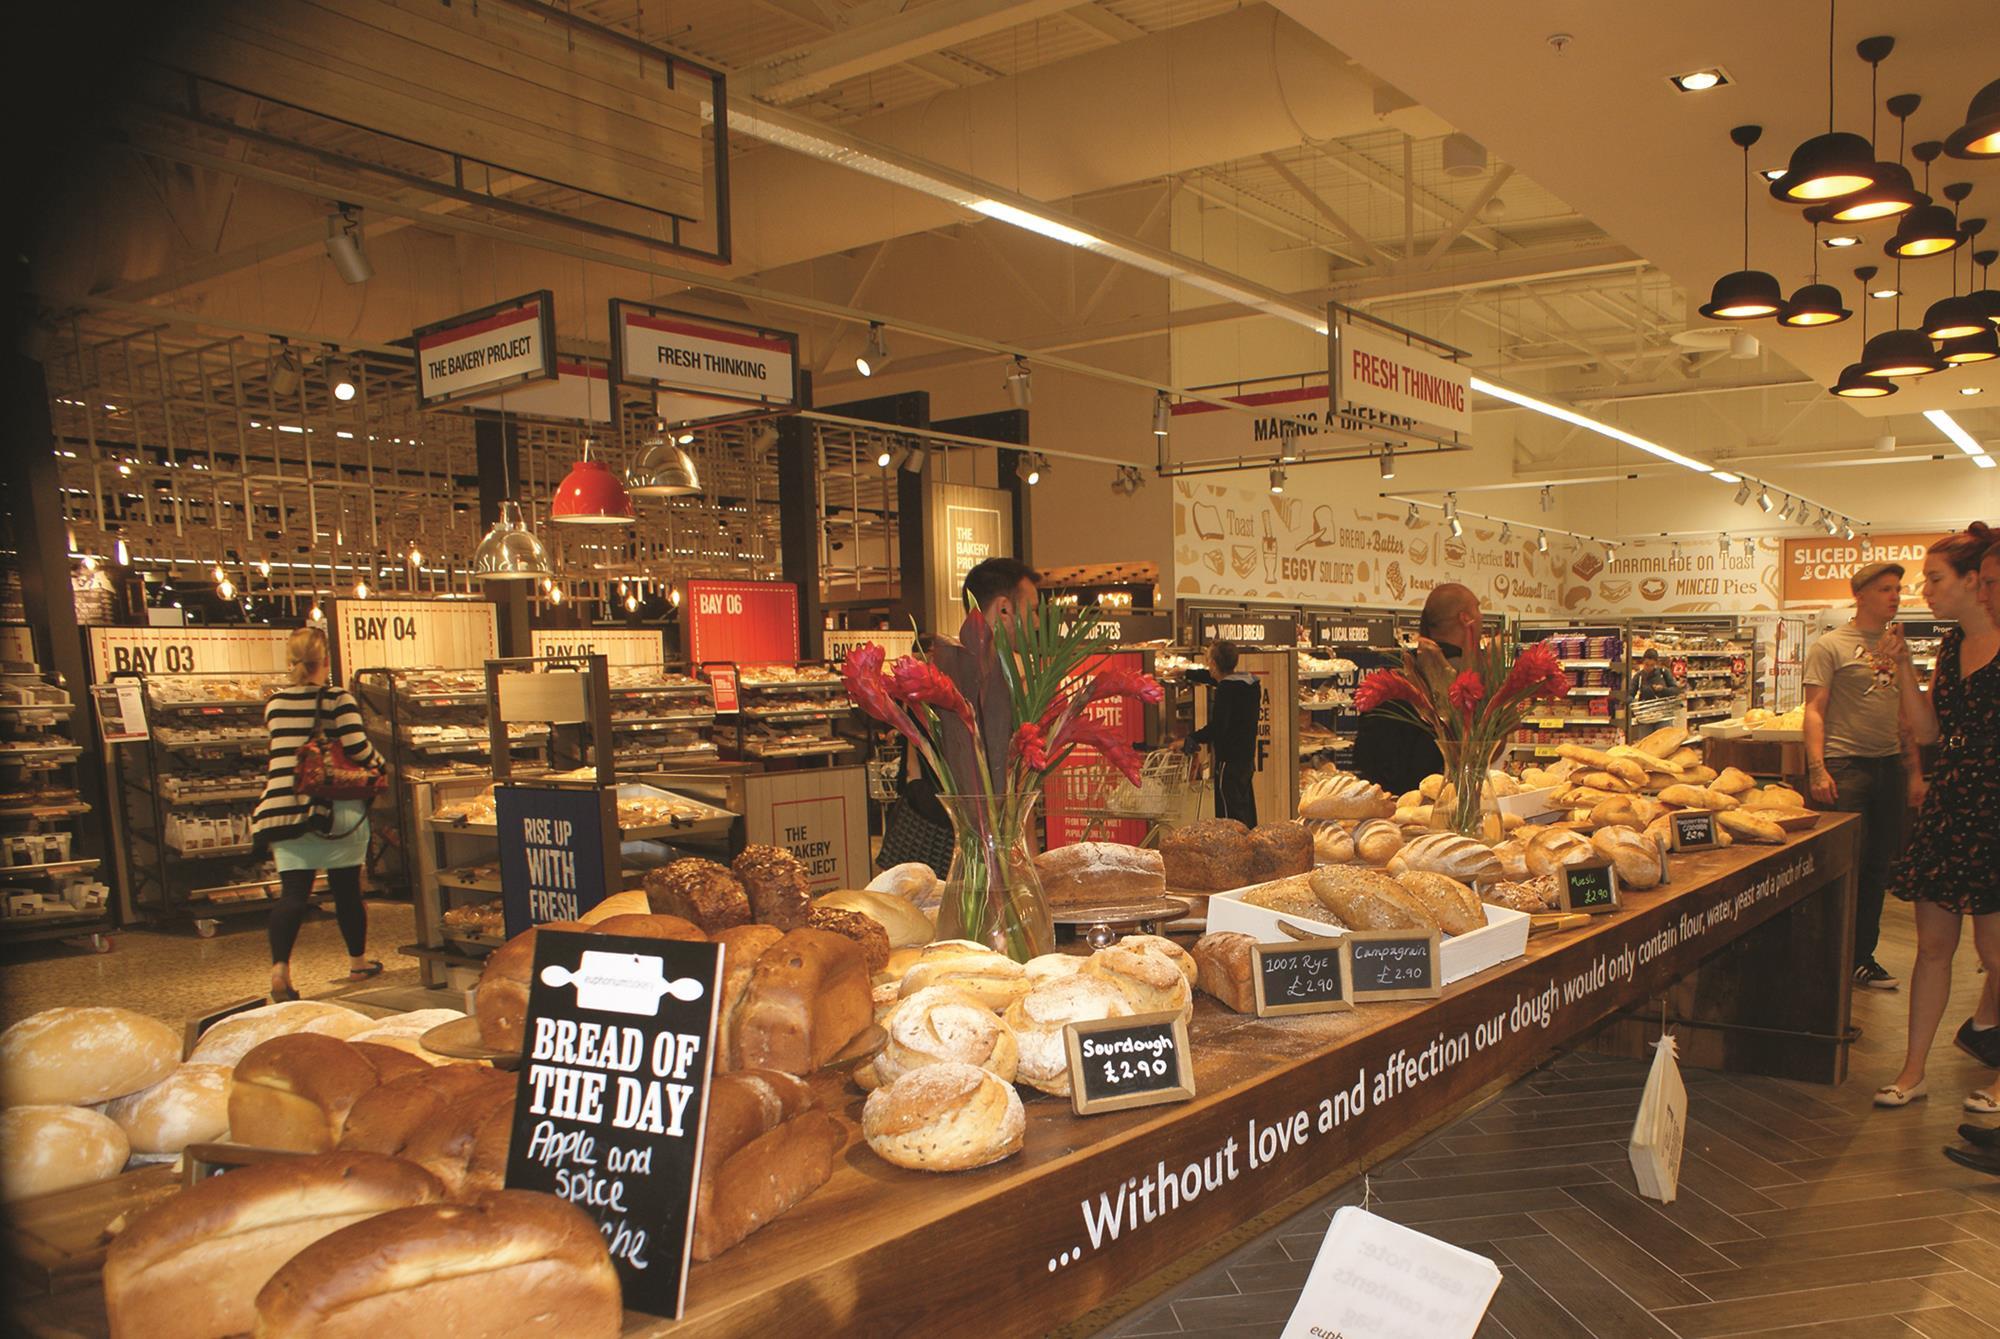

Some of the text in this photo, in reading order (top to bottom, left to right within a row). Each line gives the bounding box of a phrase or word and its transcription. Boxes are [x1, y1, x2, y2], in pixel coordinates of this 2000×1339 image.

[428, 335, 532, 380] THE BAKERY PROJECT
[657, 345, 767, 381] FRESH THINKING
[1352, 349, 1464, 413] FRESH THINKING
[956, 527, 973, 541] THE
[1226, 508, 1255, 538] Toast
[956, 541, 990, 556] BAKERY
[1339, 527, 1366, 550] BREAD
[1469, 547, 1476, 564] A
[1504, 549, 1520, 569] BLT
[1609, 552, 1755, 574] MARMALADE ON Toast
[1794, 545, 1926, 565] SLICED BREAD
[1281, 556, 1354, 585] EGGY SOLDIERS
[1813, 562, 1873, 580] CAKE
[1676, 577, 1758, 596] MINCED Pies
[699, 593, 743, 615] BAY 06
[354, 616, 417, 641] BAY 04
[1071, 620, 1121, 640] UETTES
[1217, 623, 1265, 641] WORLD BREAD
[1331, 626, 1369, 642] LOCAL HEROES
[114, 644, 195, 673] BAY 03
[545, 644, 573, 666] BAY
[523, 817, 573, 847] RISE UP
[784, 826, 808, 843] THE
[525, 847, 577, 890] WITH
[807, 857, 837, 876] JECT
[528, 888, 579, 922] FRESH
[1265, 957, 1298, 973] 100%
[1248, 1109, 1309, 1170] love
[1317, 1069, 1365, 1133] and
[1372, 1031, 1469, 1108] affection
[1474, 1011, 1506, 1052] our
[1509, 978, 1560, 1029] dough
[1563, 954, 1605, 1006] would
[1608, 944, 1636, 984] only
[1638, 917, 1678, 965] contain
[1679, 910, 1706, 942] flour,
[1706, 897, 1734, 929] water,
[1734, 884, 1755, 921] yeast
[1755, 872, 1770, 901] and
[1770, 877, 1775, 895] a
[1775, 863, 1794, 899] pinch
[1794, 856, 1802, 880] of
[531, 1016, 701, 1079] BREAD OF
[1082, 1035, 1174, 1058] Sourdough
[1104, 1058, 1168, 1084] £2.90
[528, 1063, 695, 1137] THE DAY
[526, 1120, 652, 1176] Apple and
